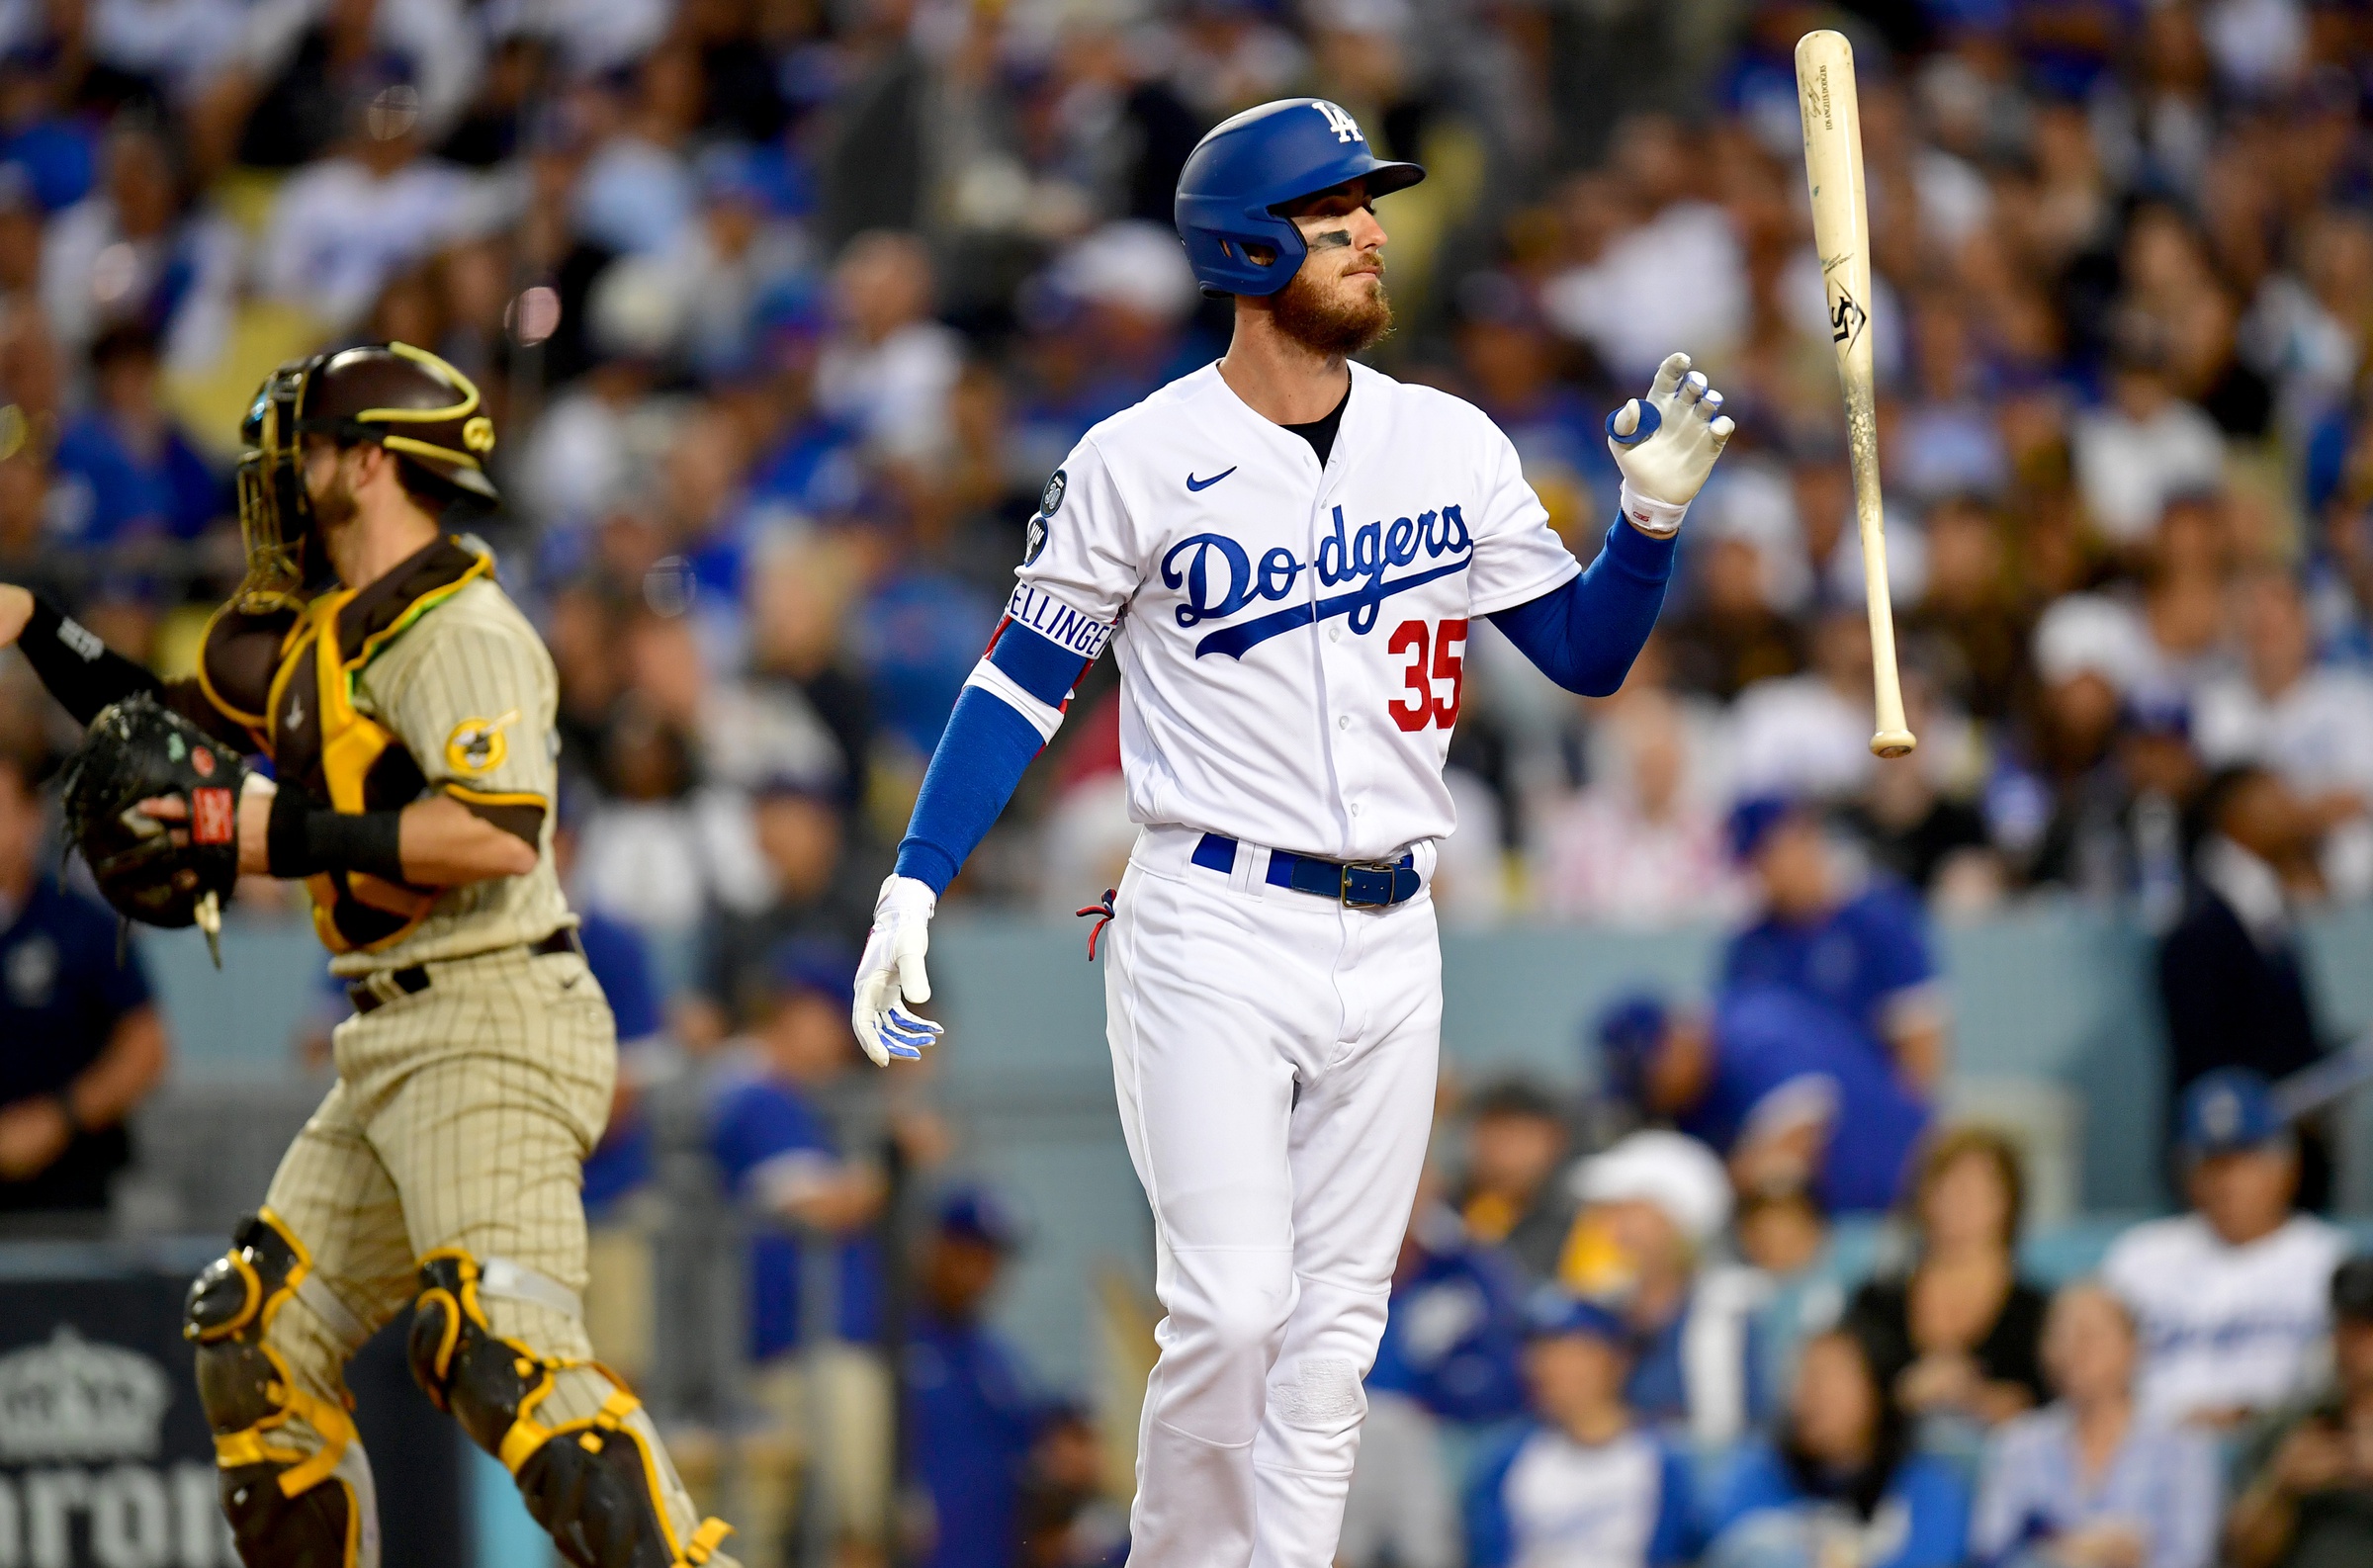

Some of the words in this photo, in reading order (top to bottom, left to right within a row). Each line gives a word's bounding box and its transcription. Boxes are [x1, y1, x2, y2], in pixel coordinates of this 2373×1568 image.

[1819, 64, 1829, 93] DODGERS
[1311, 101, 1364, 143] LA
[1821, 94, 1831, 119] ANGELES
[1161, 504, 1473, 636] Dodgers
[1387, 618, 1468, 733] 35
